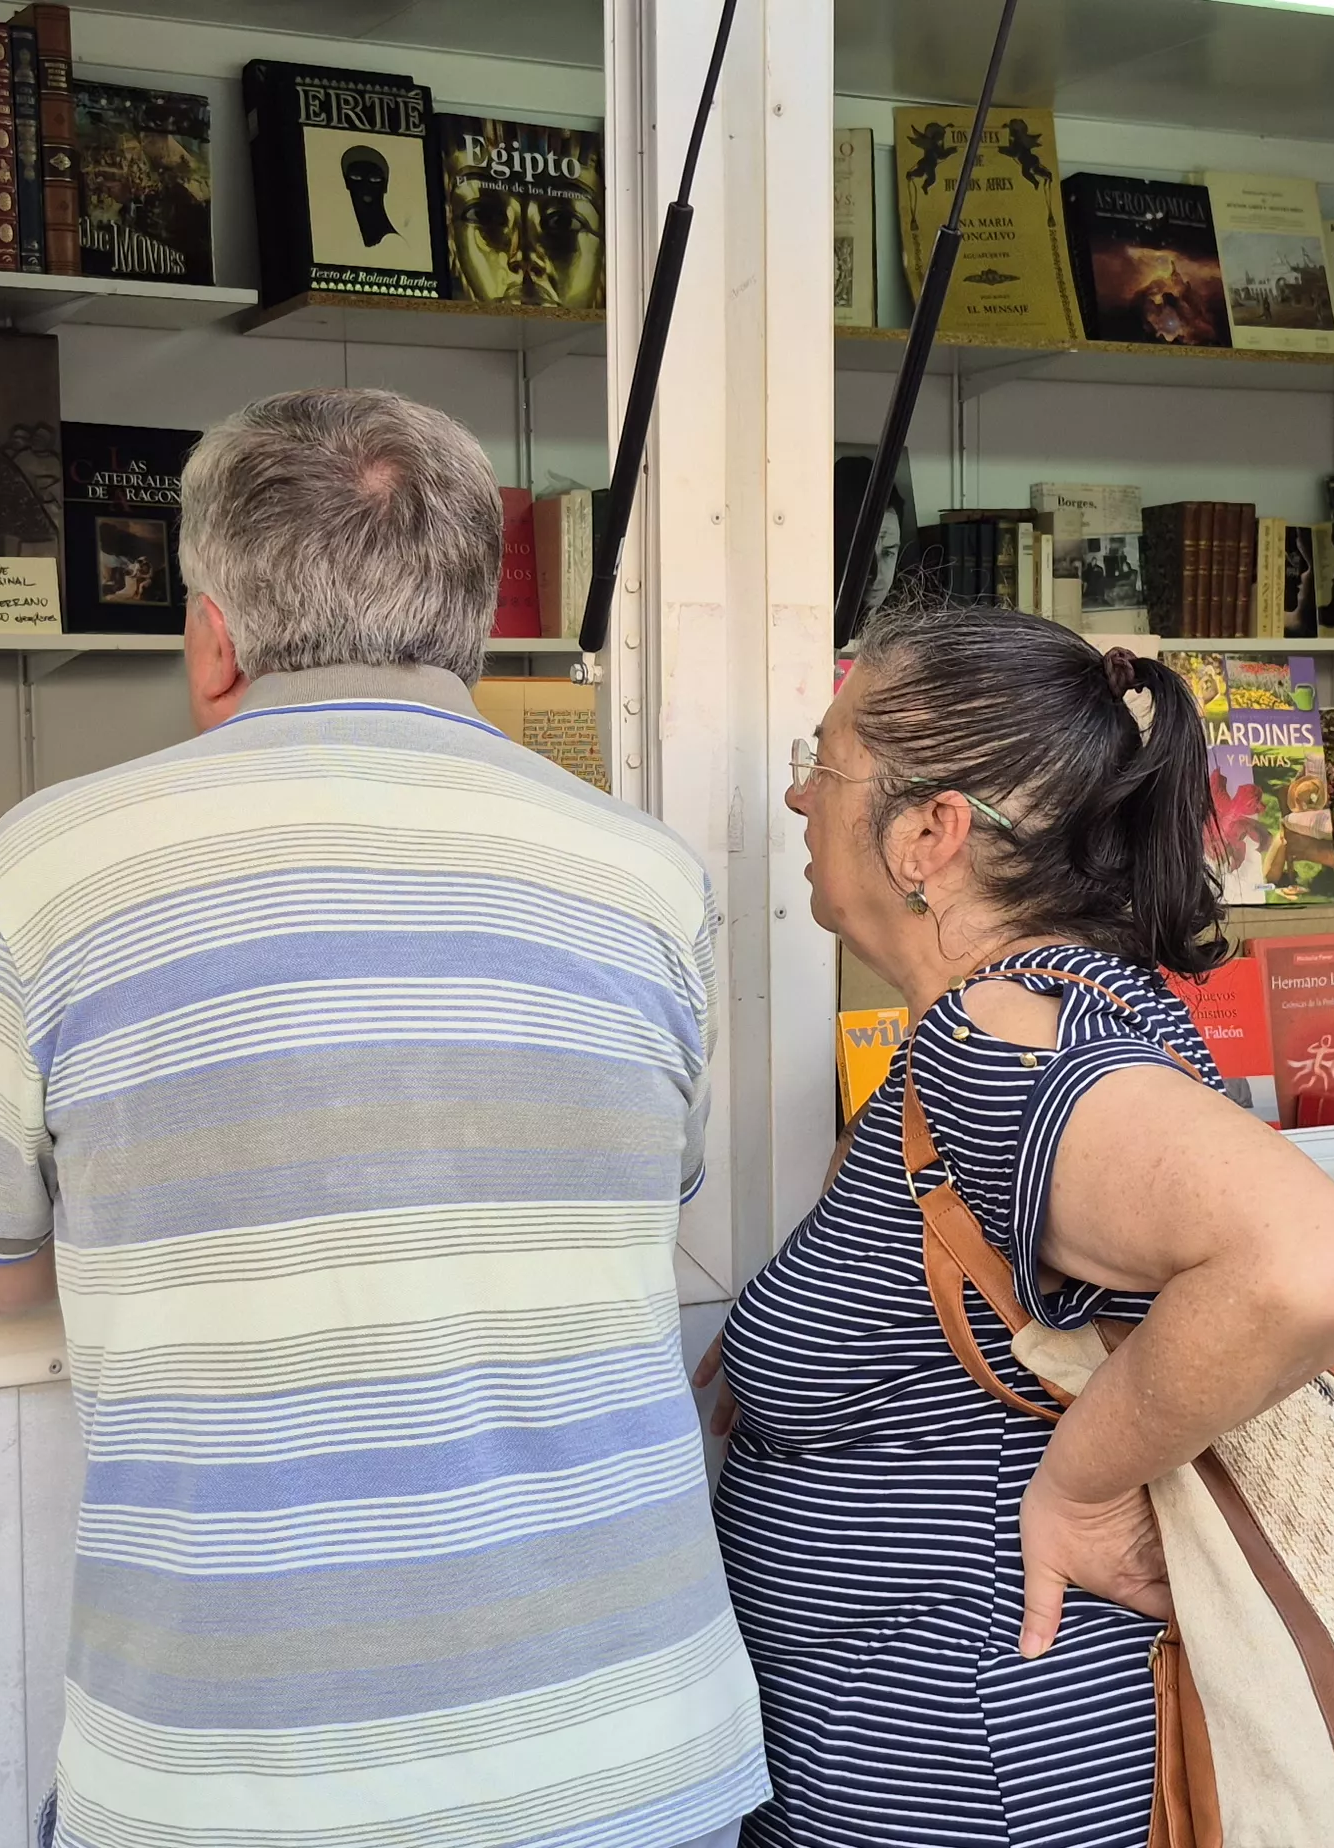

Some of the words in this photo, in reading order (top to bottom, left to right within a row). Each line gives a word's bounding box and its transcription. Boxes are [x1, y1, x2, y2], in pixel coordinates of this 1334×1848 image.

[296, 85, 427, 136] ERTÉ
[462, 134, 582, 183] Egipto
[512, 184, 524, 194] de
[528, 183, 545, 195] los
[978, 218, 1013, 228] MARIA
[310, 268, 341, 281] Texto
[343, 271, 355, 281] de
[358, 271, 398, 285] Roland
[399, 274, 438, 288] Barthes
[983, 304, 1029, 316] MENSAJE
[70, 459, 182, 489] CATEDRALES
[88, 485, 108, 499] DE
[1205, 722, 1315, 748] JARDINES
[1226, 755, 1236, 767] Y
[1238, 755, 1291, 768] PLANTAS
[1271, 975, 1328, 990] Hermano
[1196, 991, 1236, 1002] nuevos
[1204, 1025, 1244, 1039] Falcón
